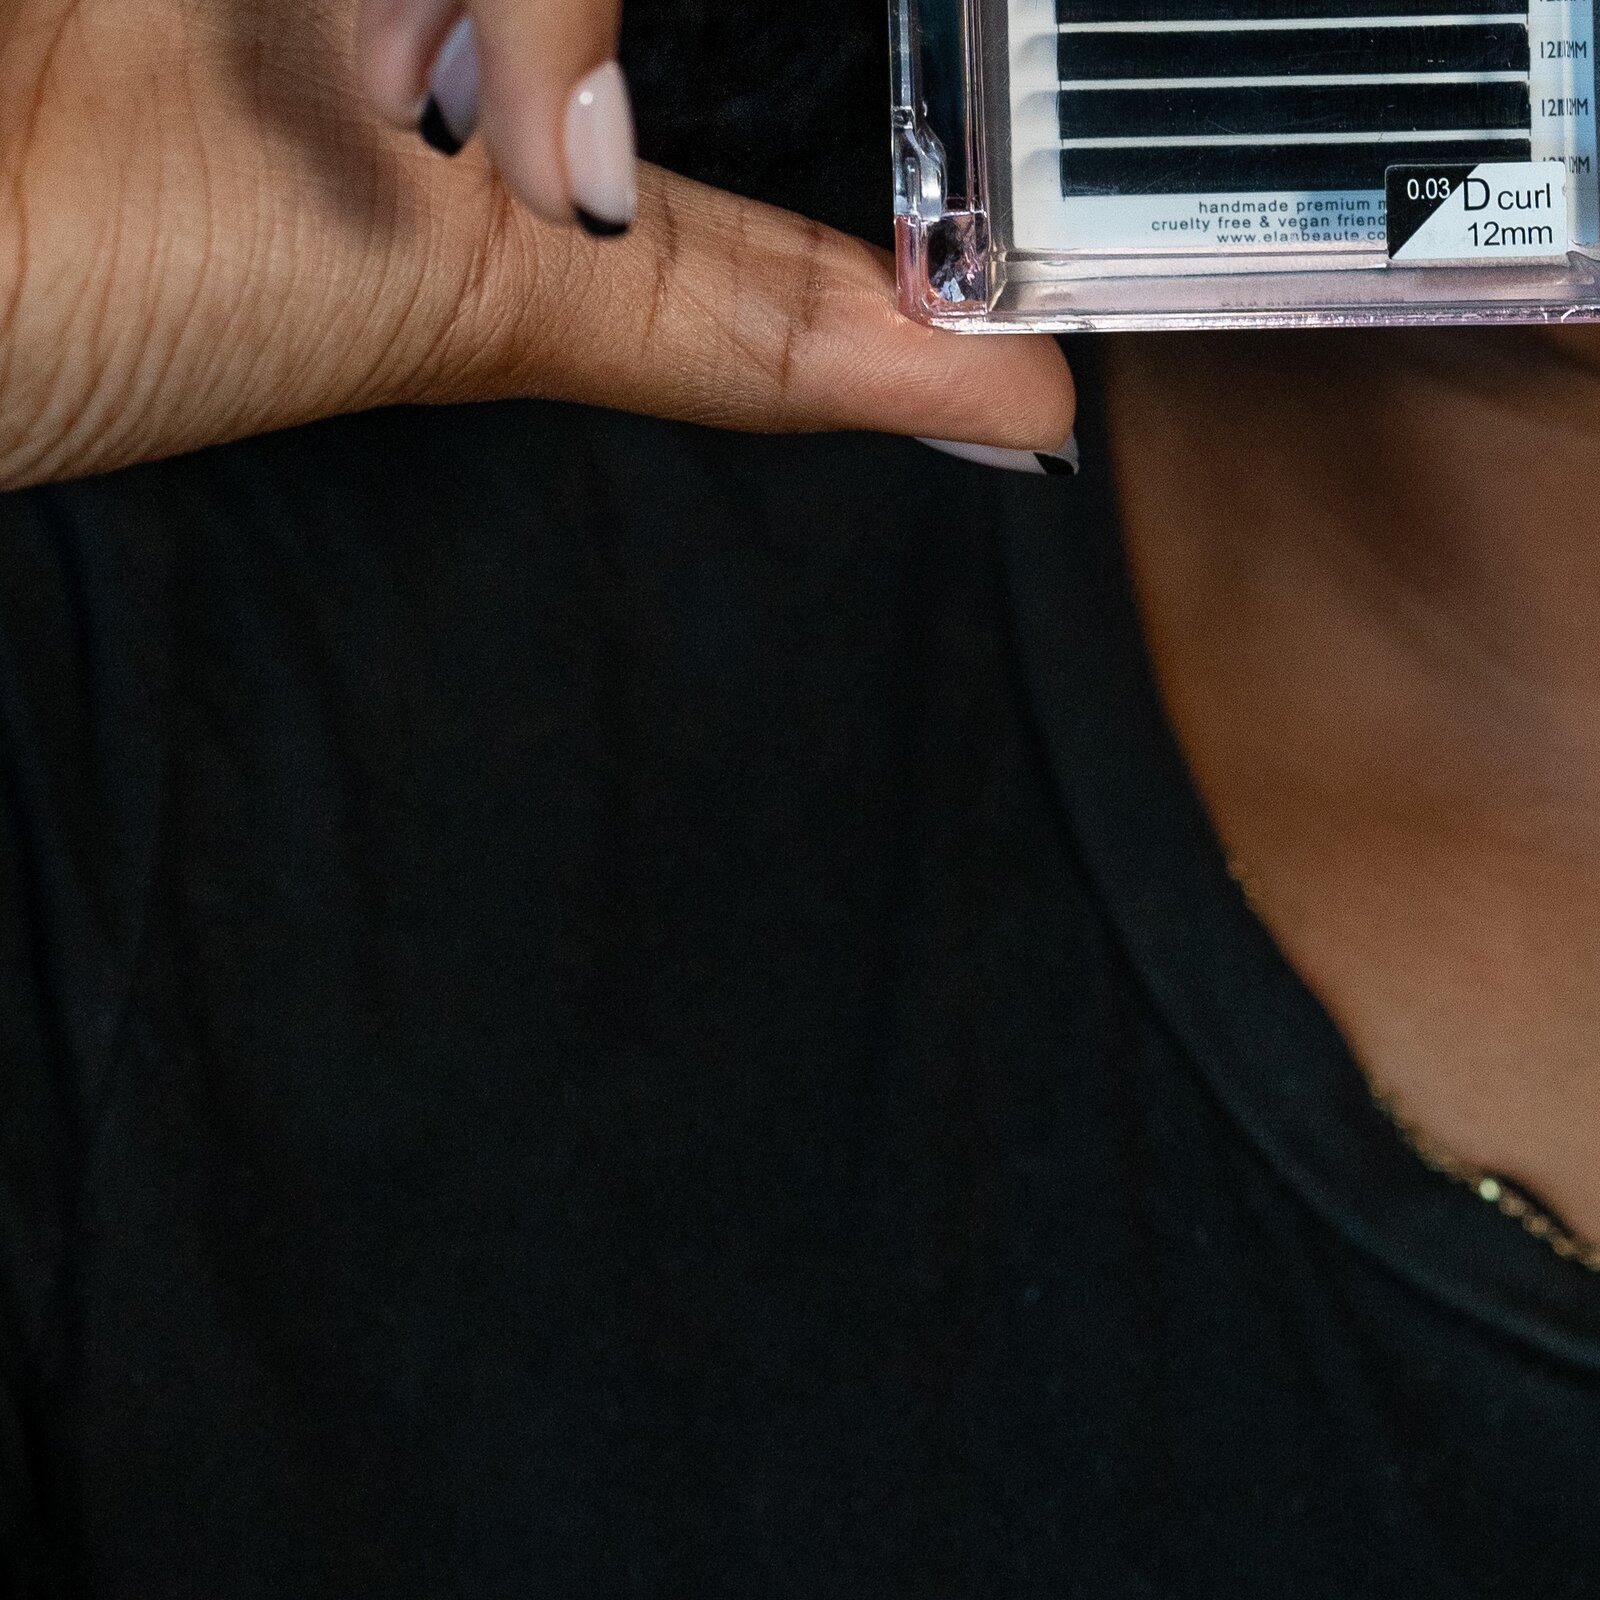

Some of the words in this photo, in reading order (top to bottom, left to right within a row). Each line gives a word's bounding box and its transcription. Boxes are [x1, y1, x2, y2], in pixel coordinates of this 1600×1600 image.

[1407, 178, 1450, 201] 0.03
[1463, 177, 1491, 211] D
[1497, 183, 1552, 211] curl
[1198, 200, 1288, 215] handmade
[1296, 198, 1370, 214] premium
[1151, 217, 1211, 232] cruelty
[1218, 215, 1252, 230] free
[1259, 215, 1271, 229] &
[1278, 217, 1330, 230] vegan
[1337, 213, 1387, 227] friend
[1216, 230, 1386, 244] www.elanbeaute.co
[1467, 220, 1553, 247] 12mm
